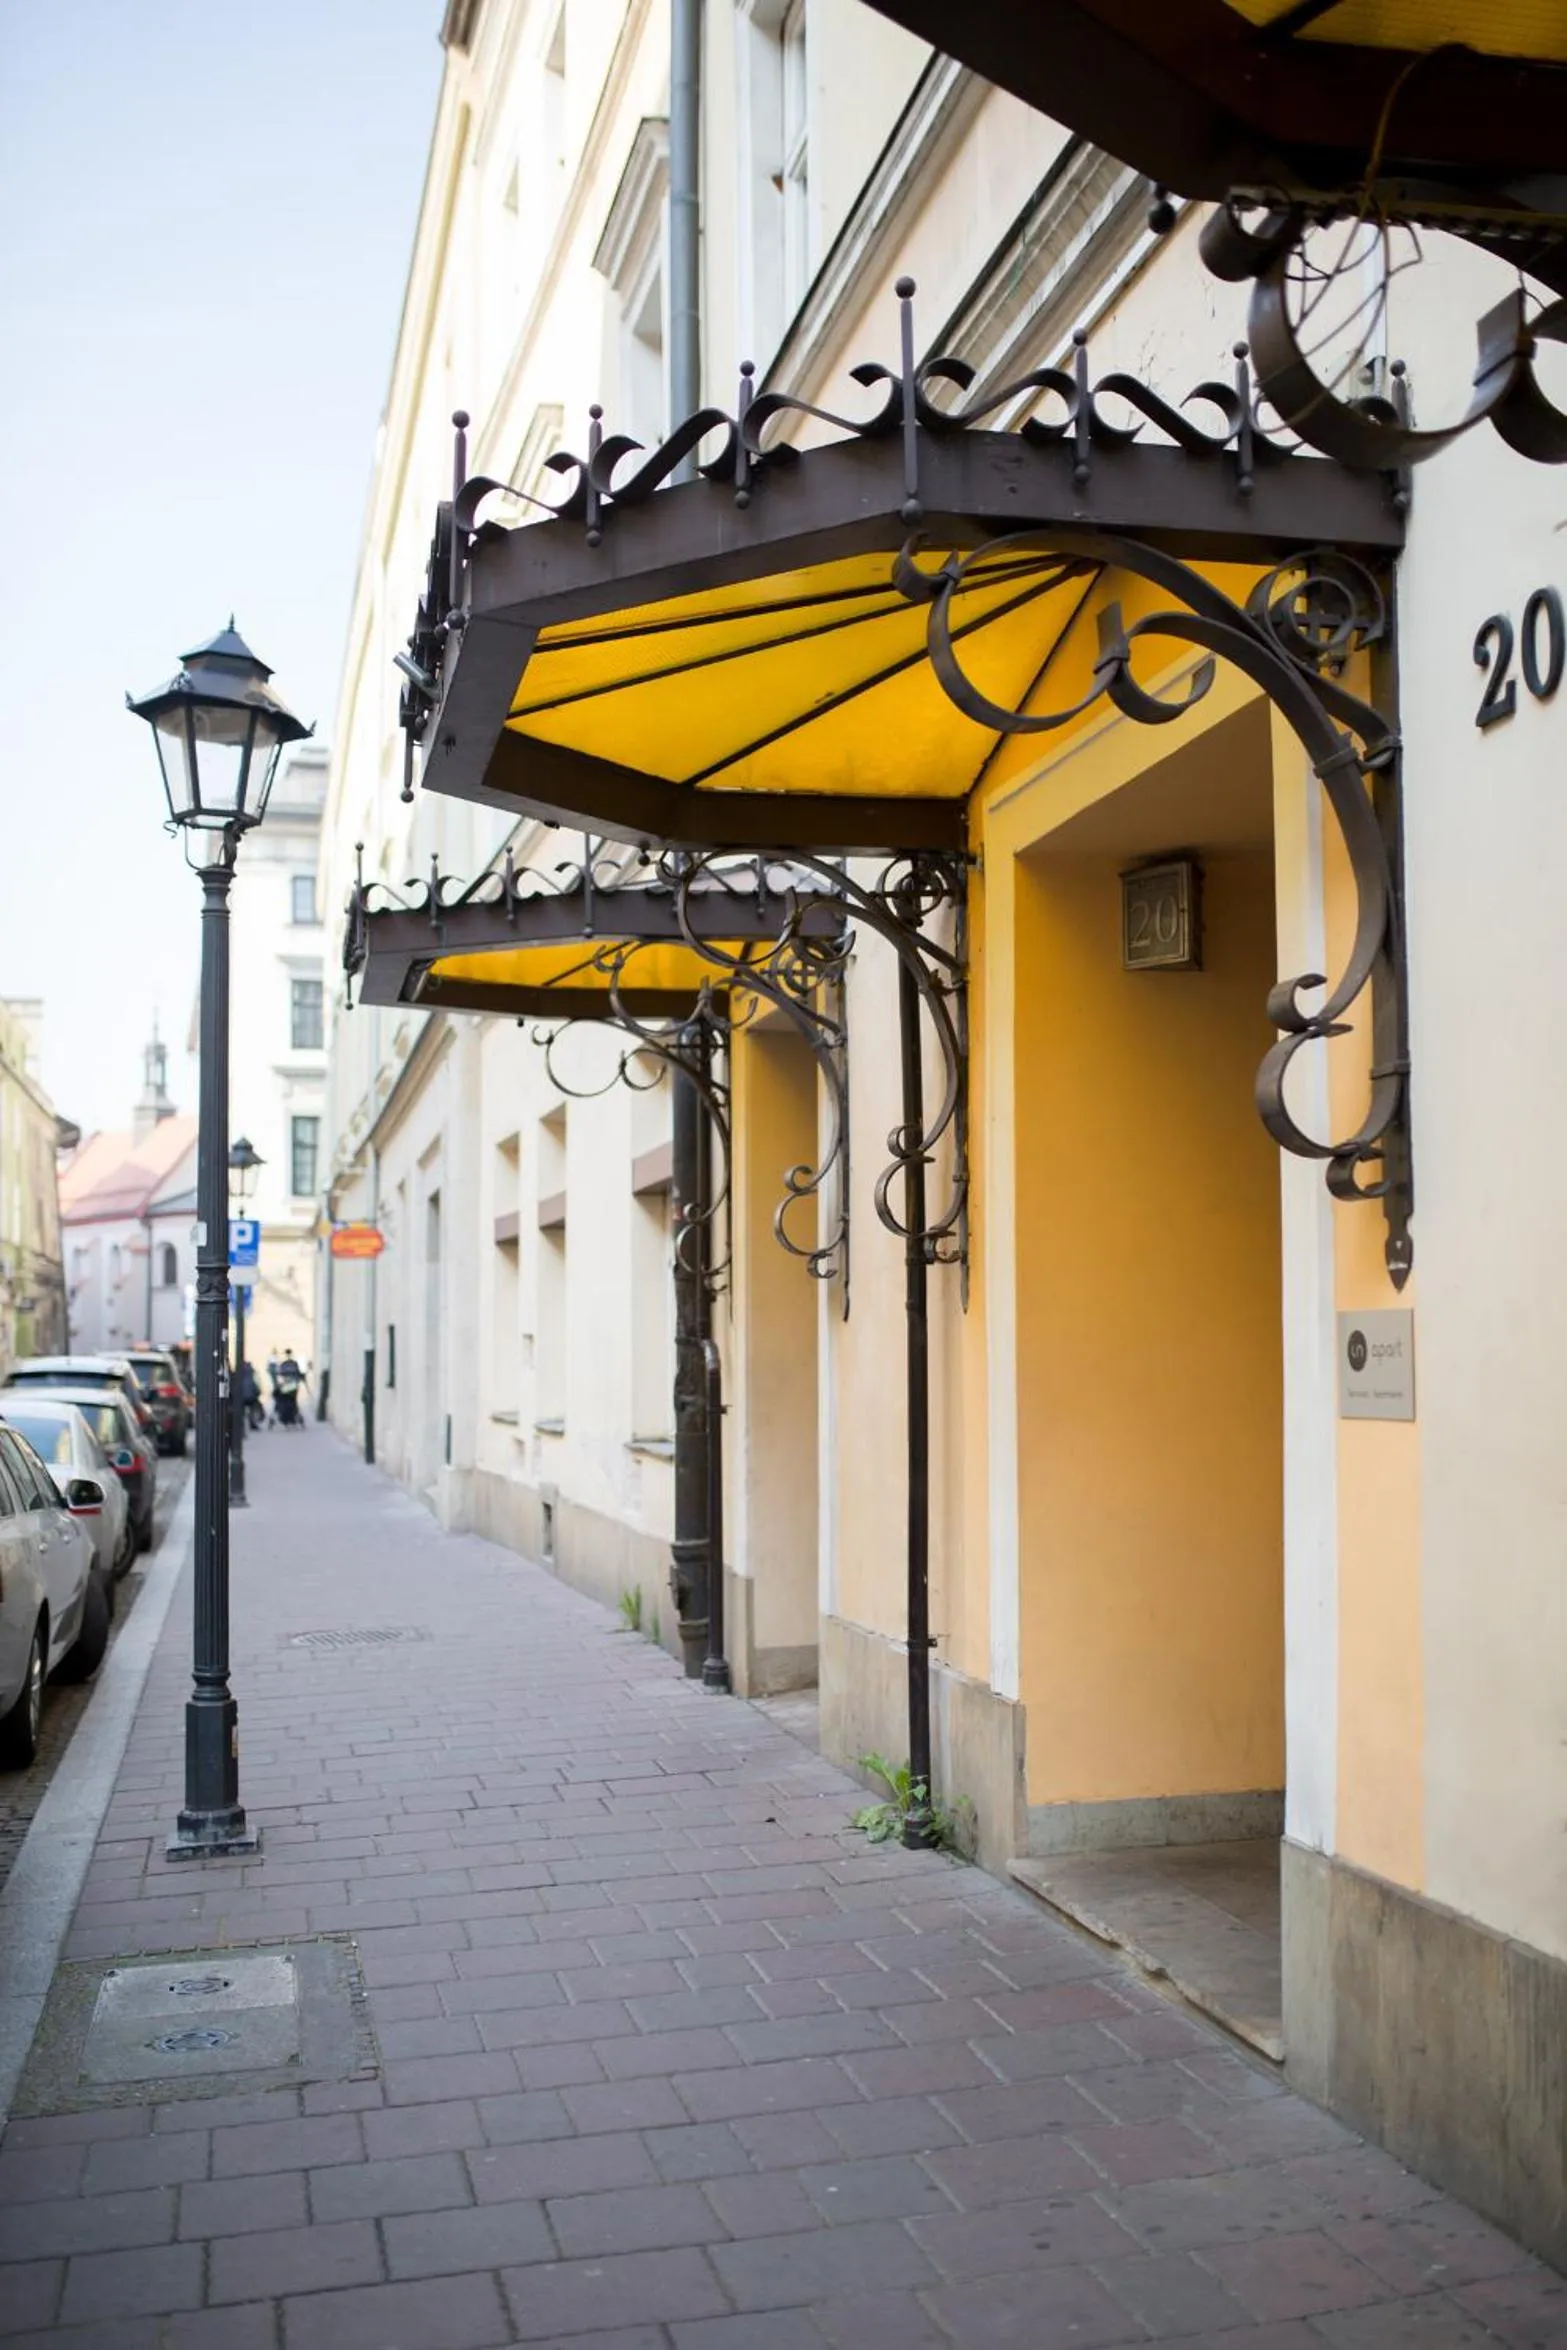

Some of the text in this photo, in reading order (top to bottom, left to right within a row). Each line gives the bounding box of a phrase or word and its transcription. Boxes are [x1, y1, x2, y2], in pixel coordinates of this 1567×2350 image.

[1473, 586, 1565, 727] 20
[1128, 895, 1178, 948] 20
[229, 1221, 254, 1252] P
